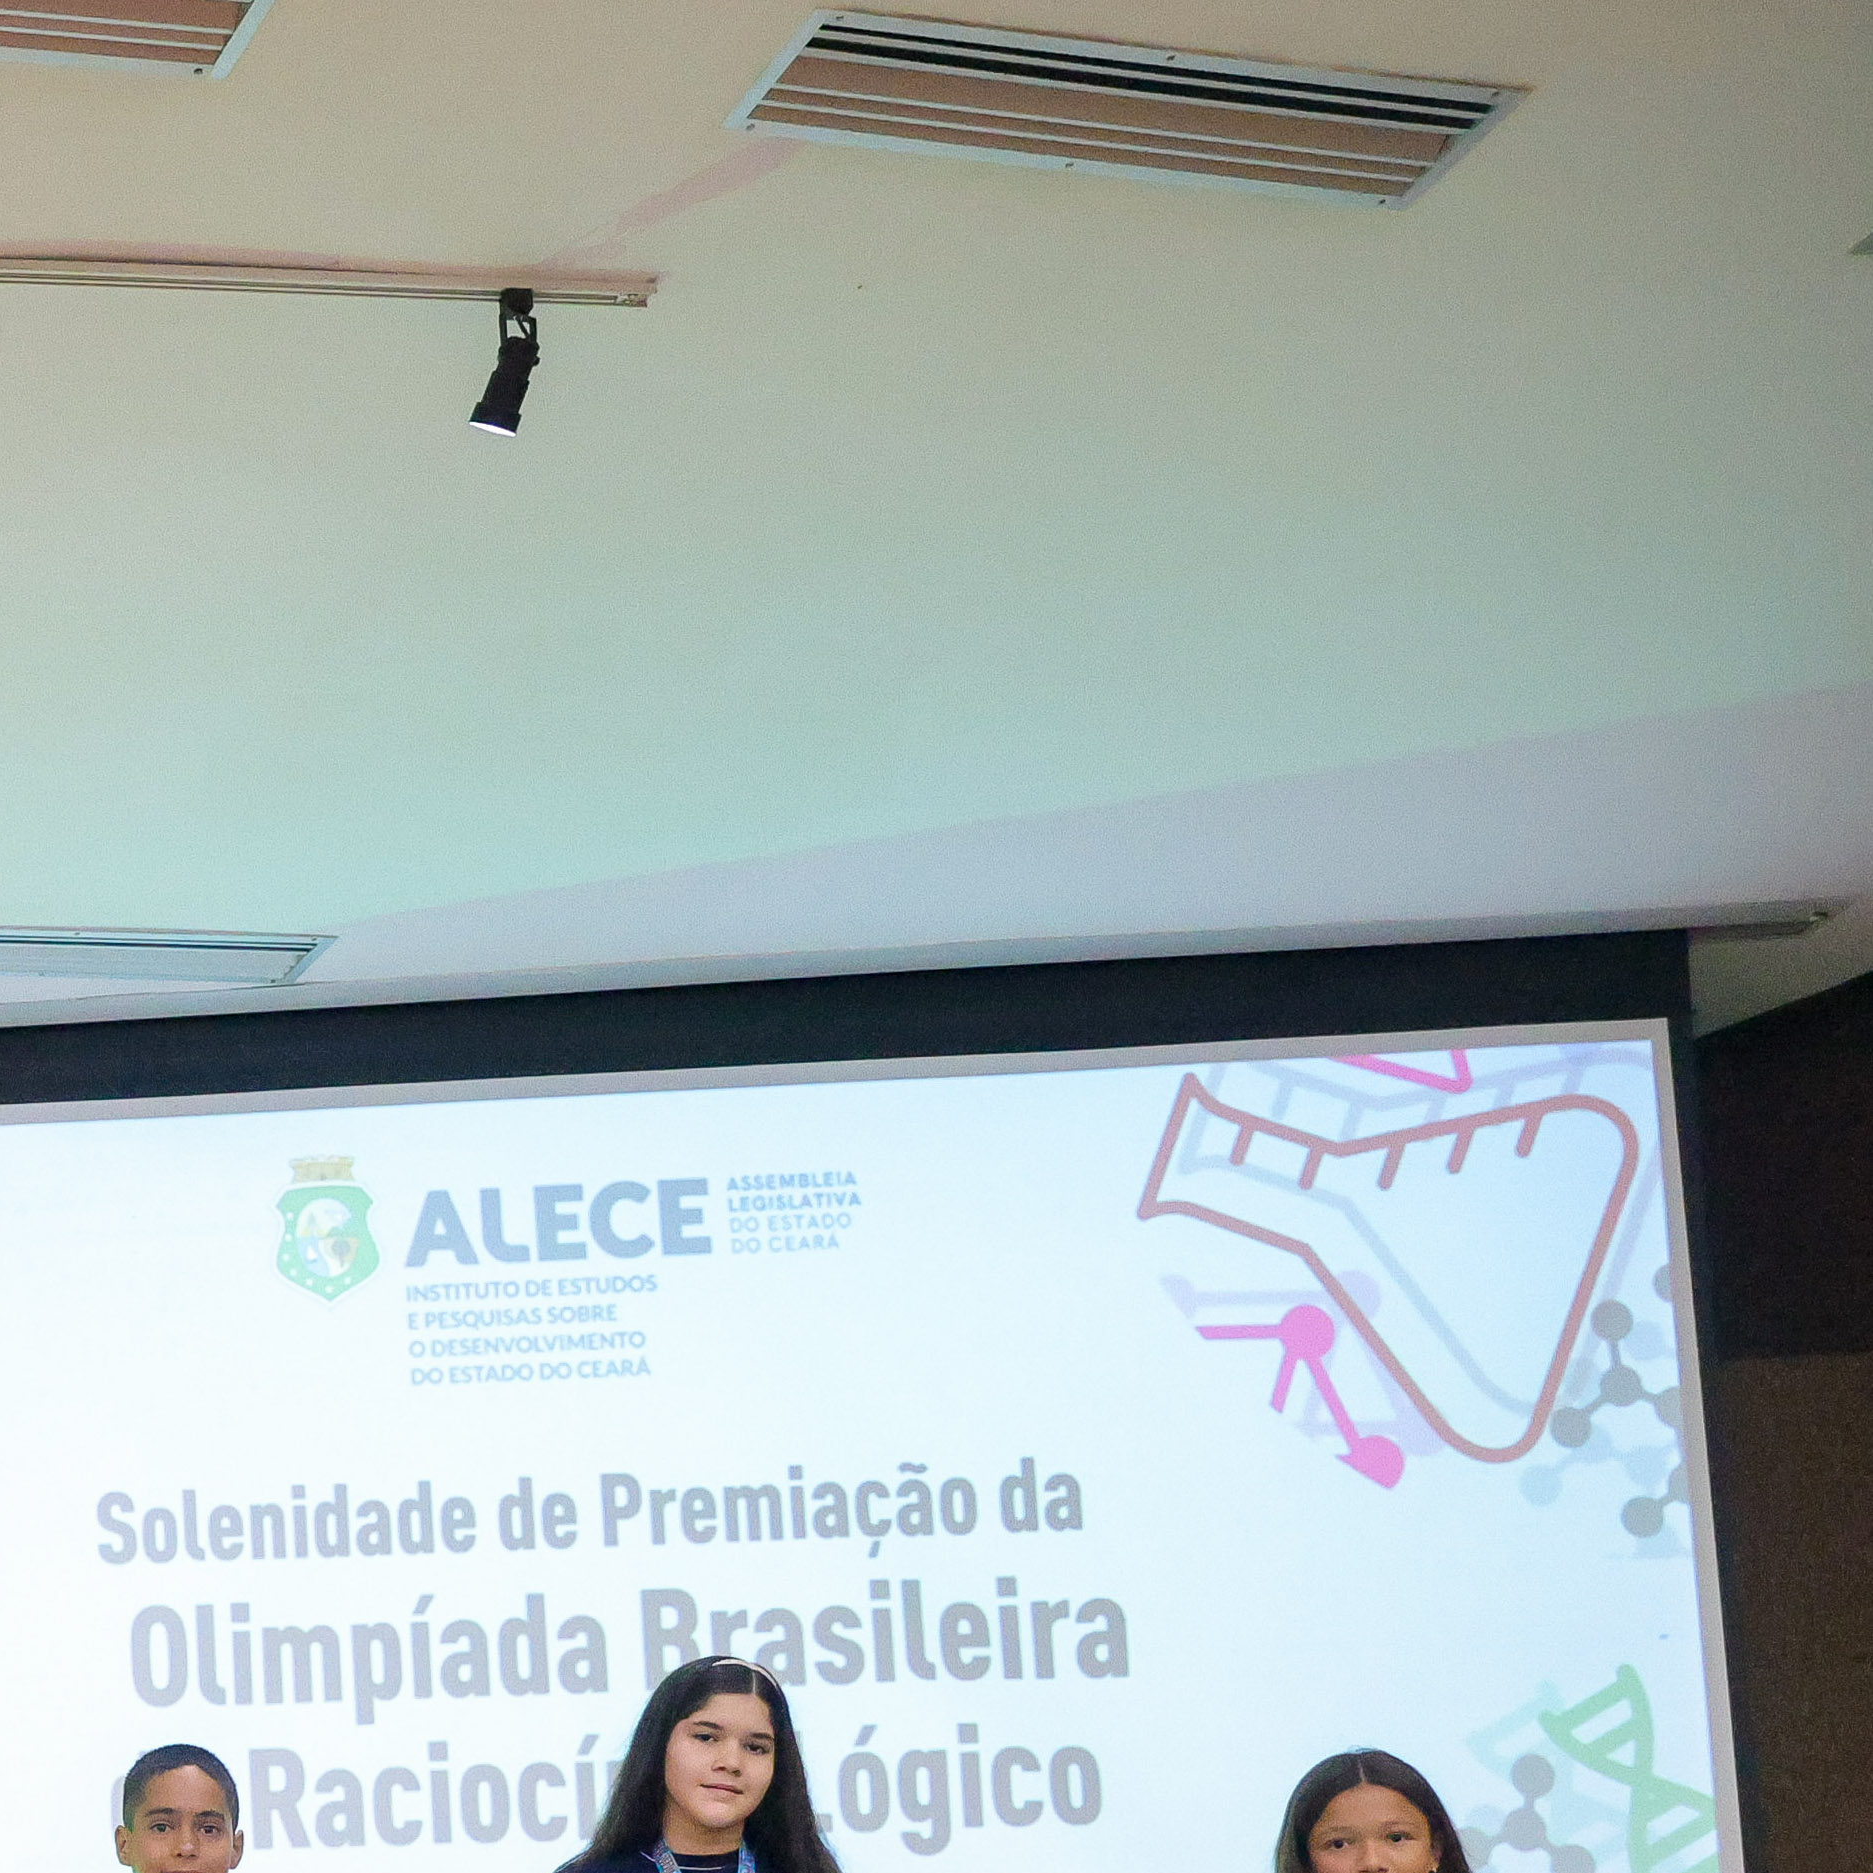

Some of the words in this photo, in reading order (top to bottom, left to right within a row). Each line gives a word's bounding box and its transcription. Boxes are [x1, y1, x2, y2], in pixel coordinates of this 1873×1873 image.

[726, 1171, 858, 1191] ASSEMBLEIA
[728, 1192, 862, 1212] LEGISLATIVA
[405, 1178, 713, 1267] ALECE
[730, 1214, 760, 1233] DO
[767, 1212, 853, 1232] ESTADO
[731, 1236, 761, 1254] DO
[769, 1232, 841, 1252] CEARÁ
[405, 1280, 521, 1303] INSTITUTO
[524, 1279, 553, 1298] DE
[556, 1274, 659, 1297] ESTUDOS
[408, 1312, 419, 1331] E
[423, 1306, 543, 1331] PESQUISAS
[546, 1304, 618, 1326] SOBRE
[409, 1341, 426, 1359] O
[430, 1331, 646, 1358] DESENVOLVIMENTO
[410, 1366, 444, 1387] DO
[447, 1363, 536, 1384] ESTADO
[538, 1362, 572, 1382] DO
[576, 1355, 652, 1379] CEARÁ
[95, 1479, 479, 1566] Solenidade
[498, 1476, 579, 1551] de
[600, 1461, 979, 1558] Premiação
[998, 1456, 1085, 1534] da
[130, 1592, 609, 1726] Olimpíada
[640, 1573, 1131, 1694] Brasileira
[248, 1732, 628, 1852] Raciocí
[810, 1722, 1103, 1857] ógico
